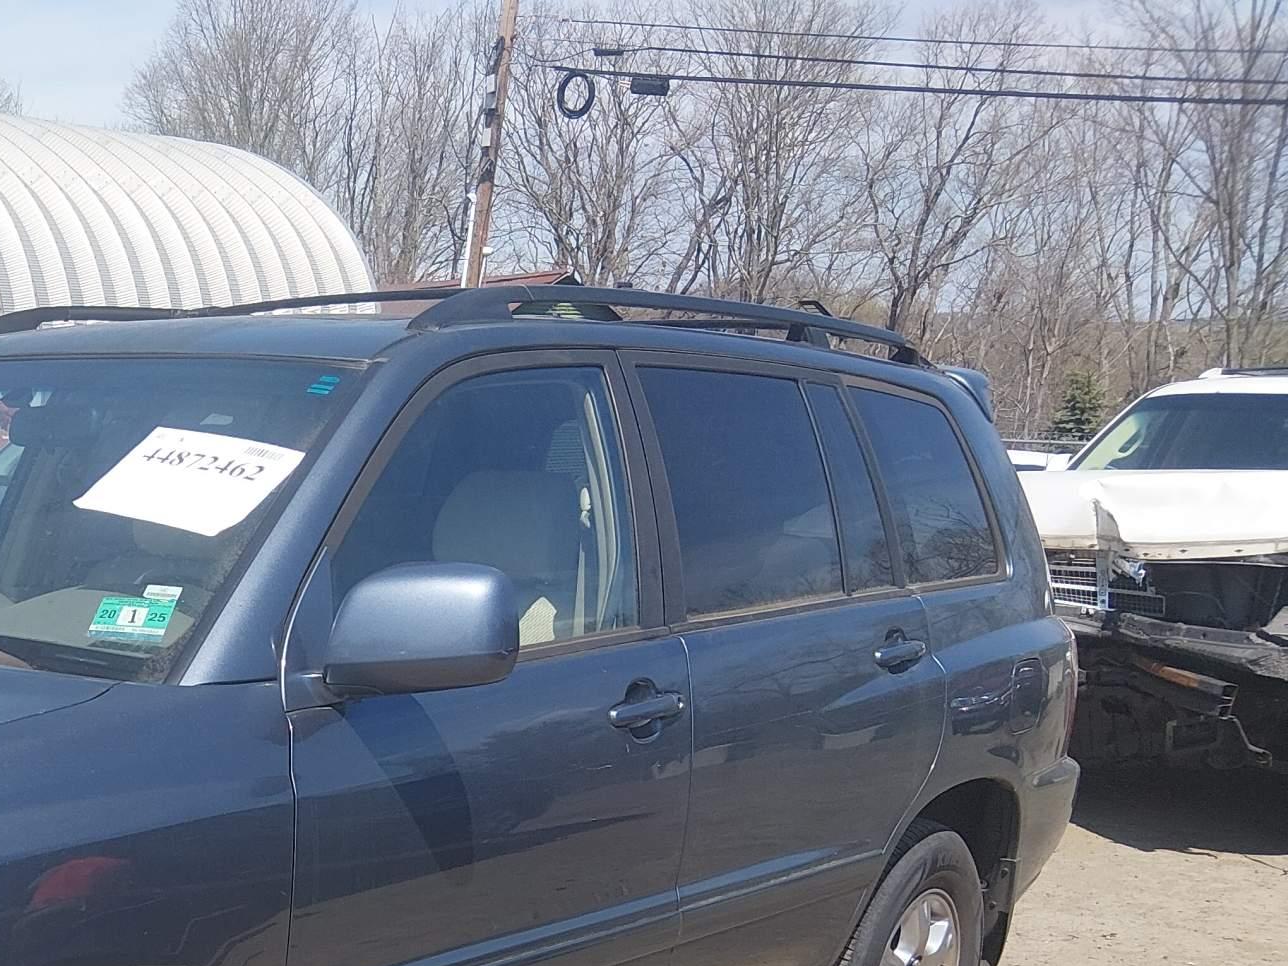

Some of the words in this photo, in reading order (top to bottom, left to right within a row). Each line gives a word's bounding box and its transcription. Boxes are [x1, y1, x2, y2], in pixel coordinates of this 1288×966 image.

[143, 447, 265, 481] 44872462
[99, 609, 117, 619] 20
[127, 608, 137, 624] 1
[147, 612, 166, 623] 25
